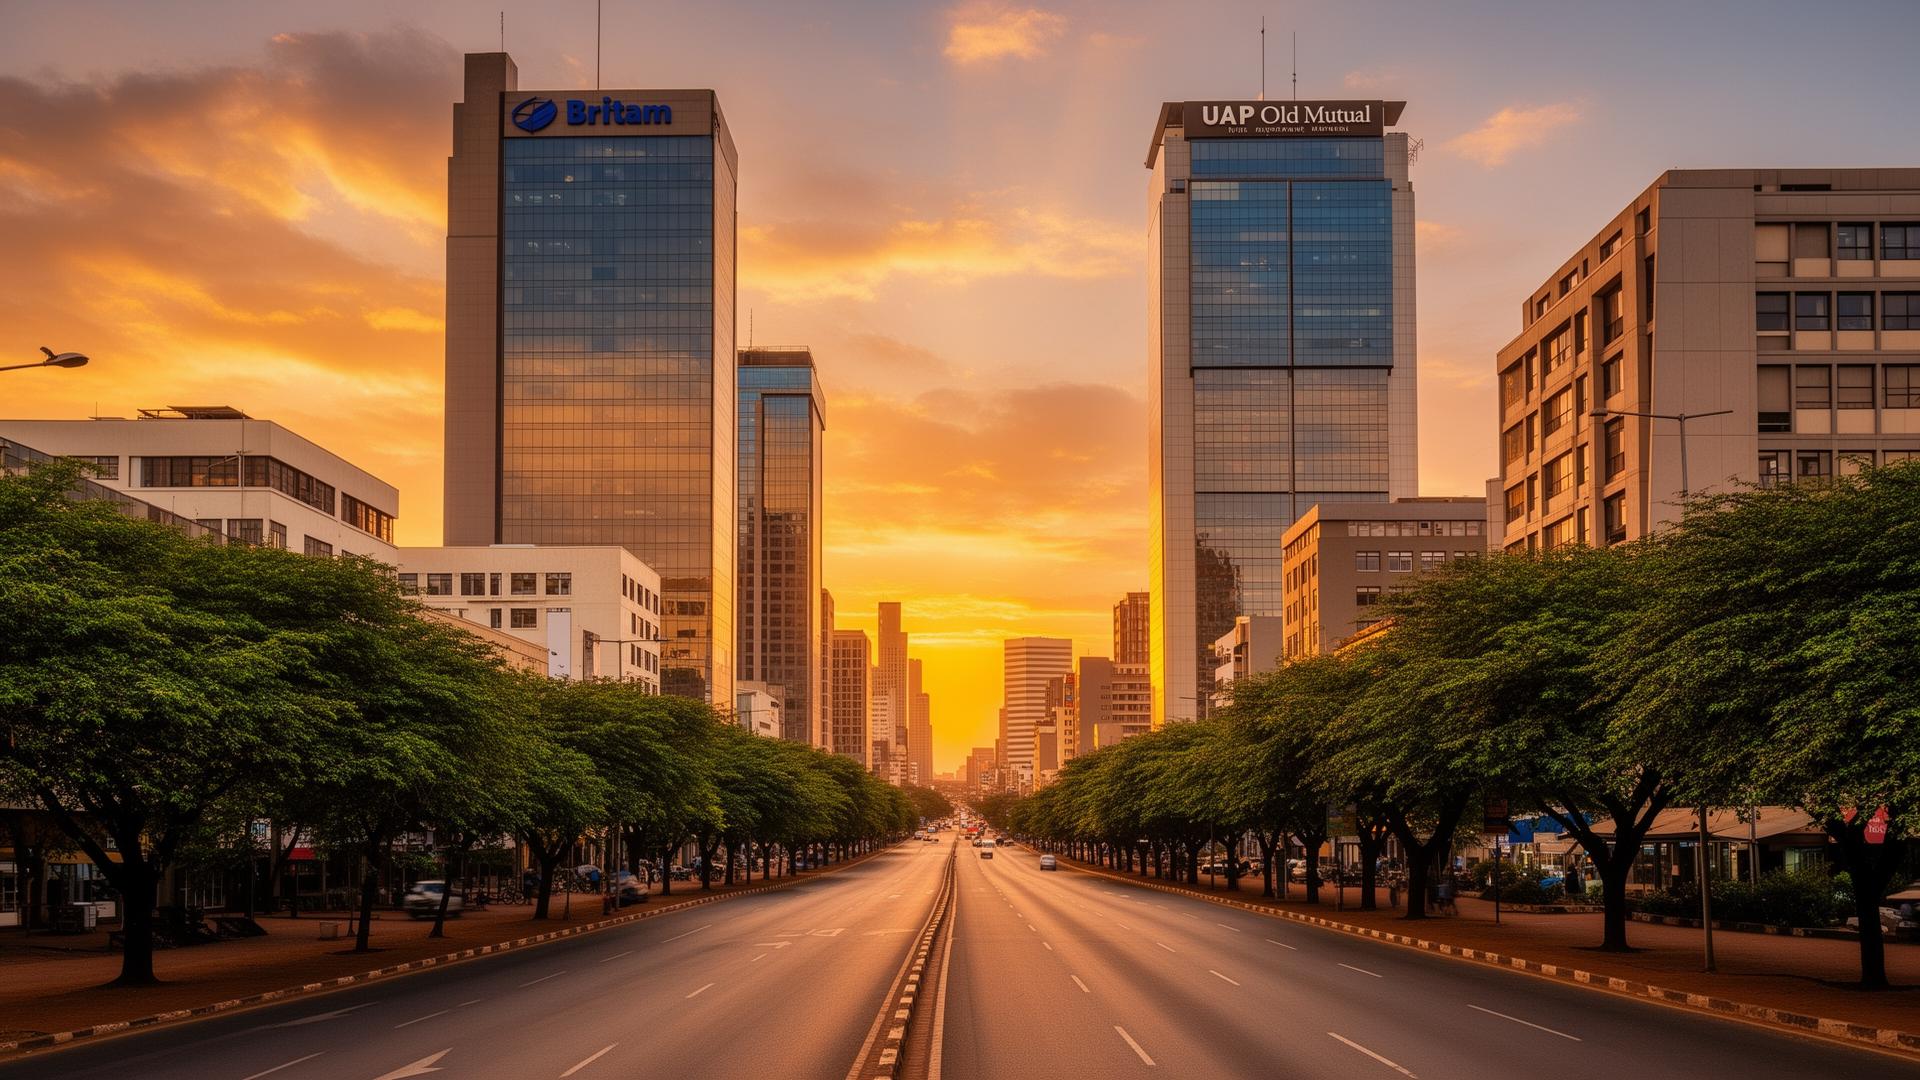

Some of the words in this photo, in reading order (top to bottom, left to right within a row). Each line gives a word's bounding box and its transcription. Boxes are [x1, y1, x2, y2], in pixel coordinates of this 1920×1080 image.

[567, 97, 672, 125] Britam
[1202, 105, 1254, 125] UAP
[1260, 105, 1299, 125] Old
[1304, 104, 1371, 123] Mutual
